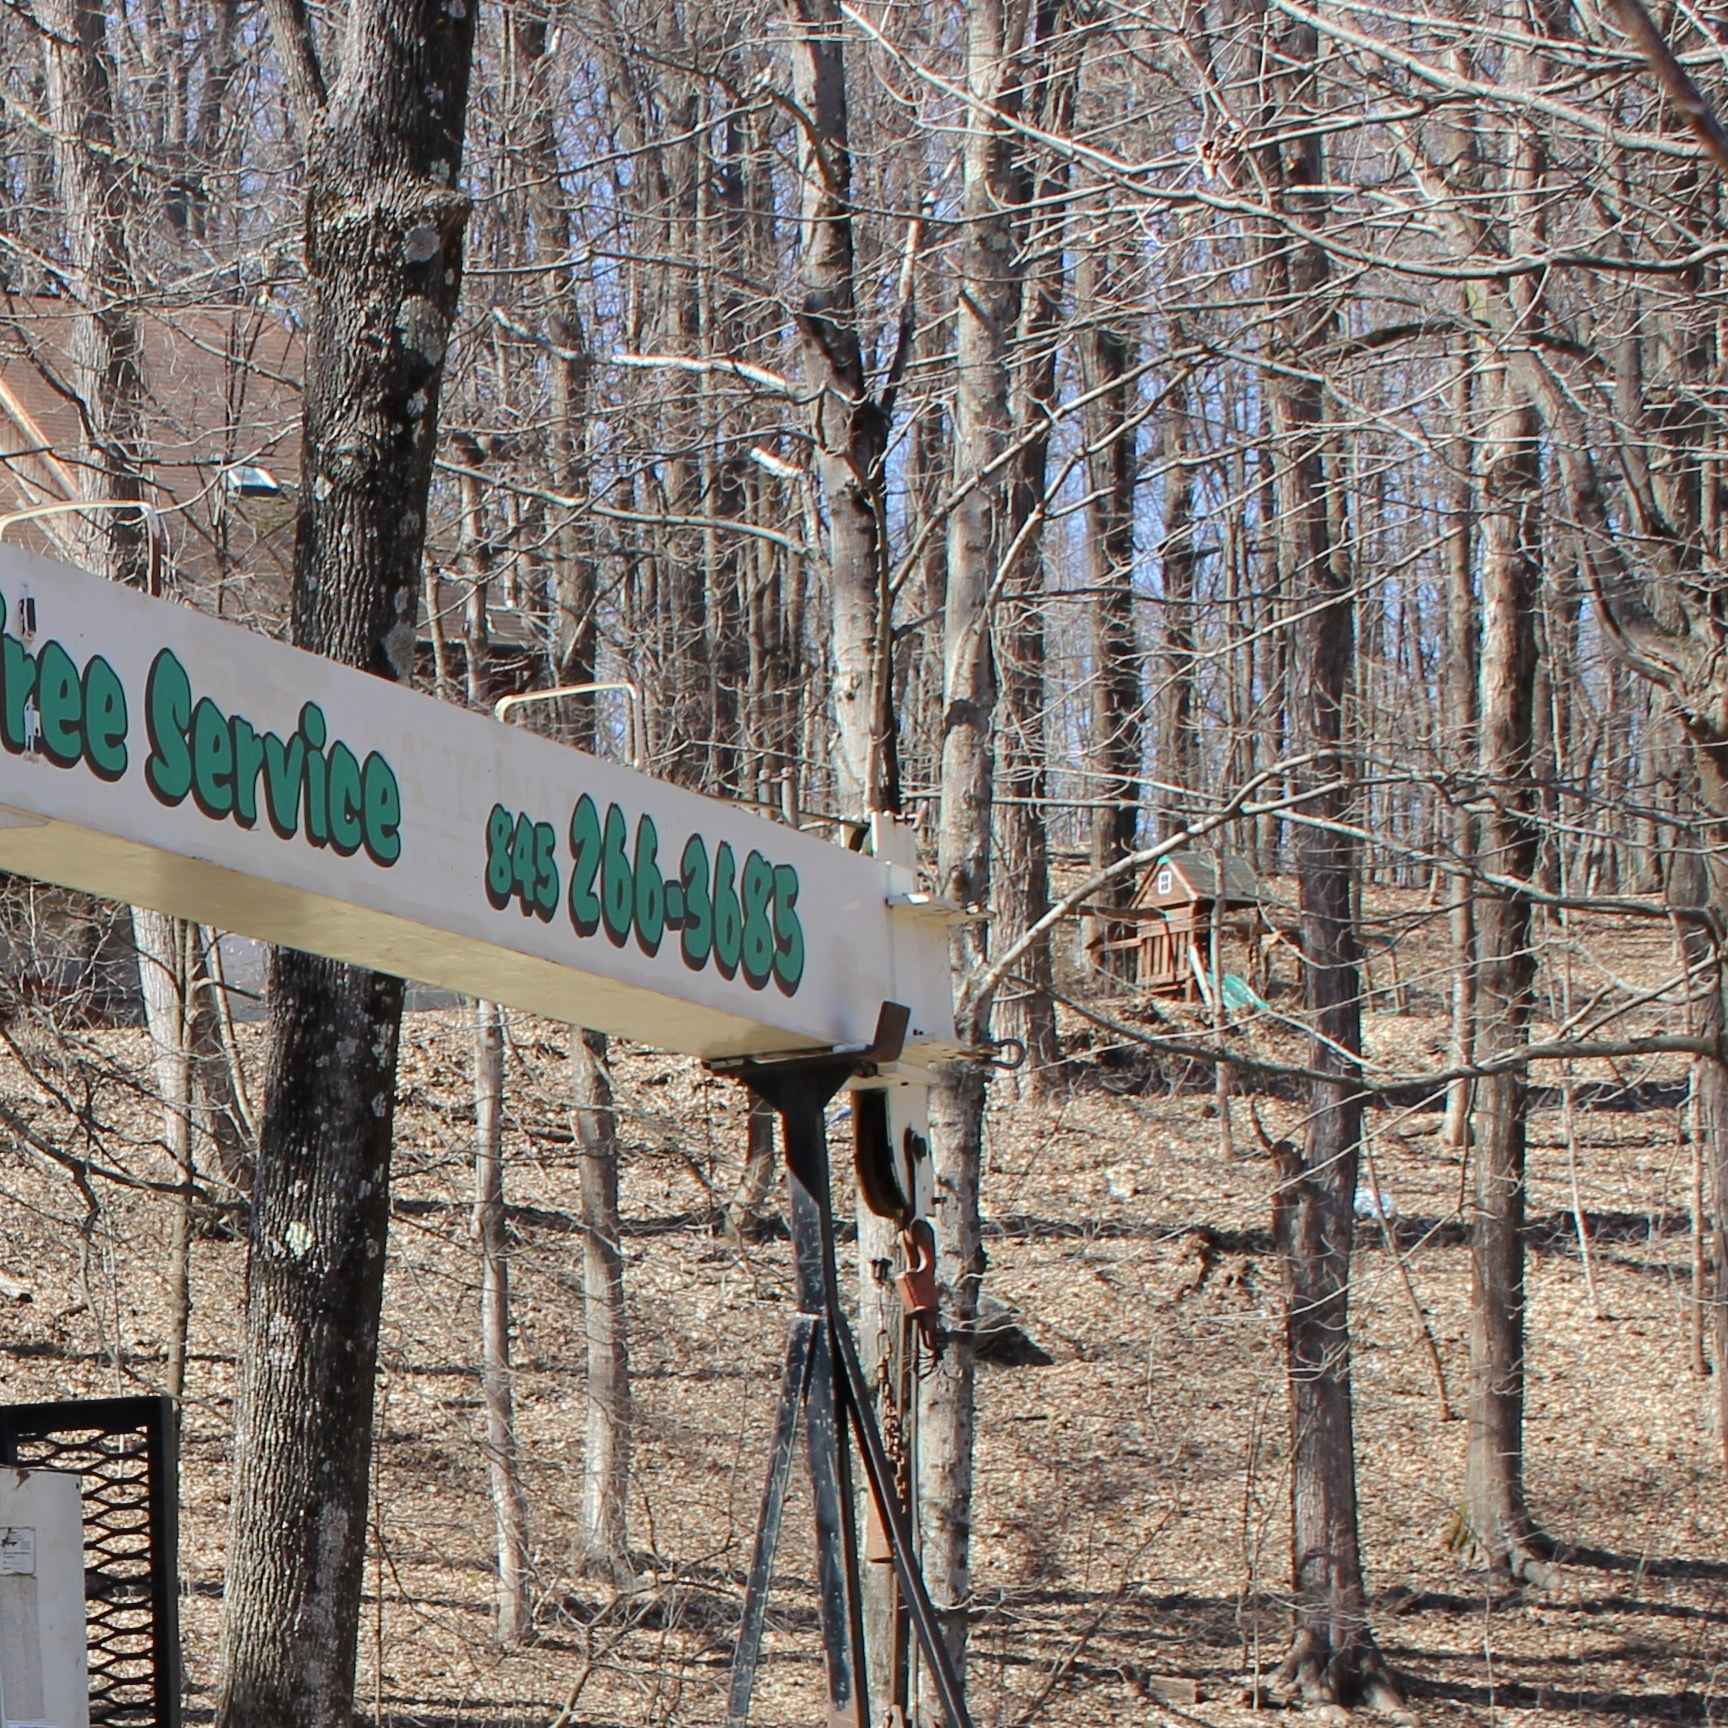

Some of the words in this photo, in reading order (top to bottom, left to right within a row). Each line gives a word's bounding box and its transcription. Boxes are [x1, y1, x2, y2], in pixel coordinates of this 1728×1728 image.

[144, 647, 402, 868] Service
[485, 803, 560, 923] 845
[569, 793, 805, 998] 266-3685
